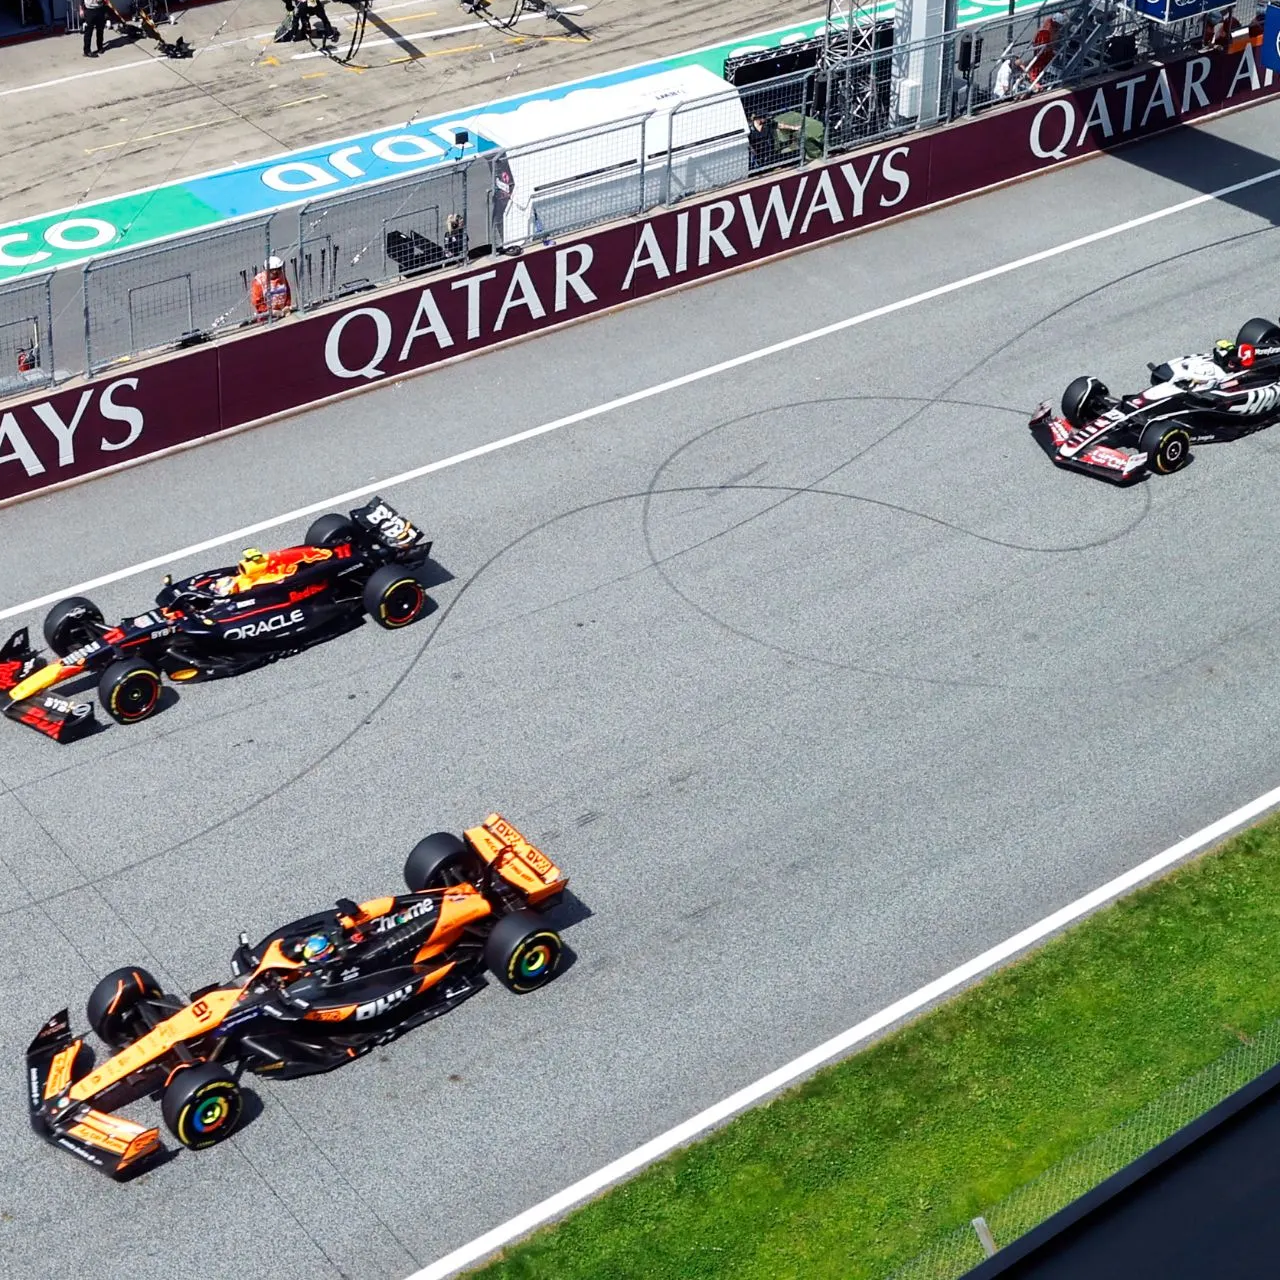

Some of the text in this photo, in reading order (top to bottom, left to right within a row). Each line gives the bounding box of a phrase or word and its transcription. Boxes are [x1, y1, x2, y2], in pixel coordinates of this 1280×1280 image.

[1029, 57, 1211, 161] QATAR
[325, 147, 909, 379] QATAR AIRWAYS
[335, 544, 352, 559] 11
[223, 609, 305, 641] ORACLE
[370, 897, 435, 933] Chrome
